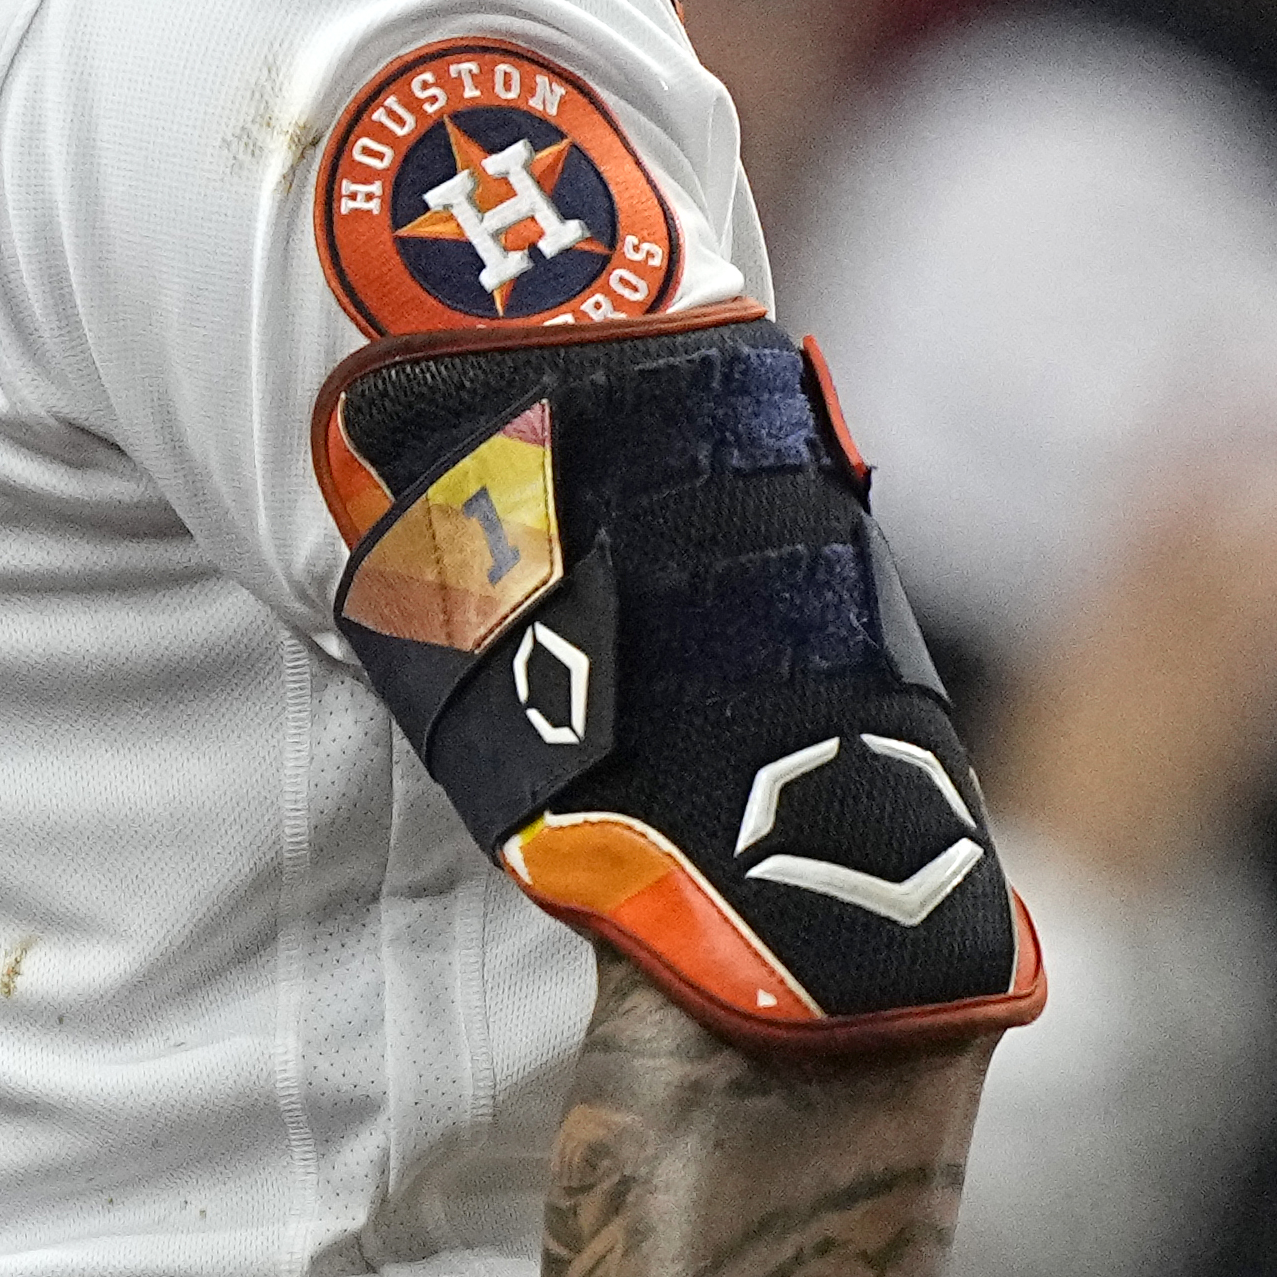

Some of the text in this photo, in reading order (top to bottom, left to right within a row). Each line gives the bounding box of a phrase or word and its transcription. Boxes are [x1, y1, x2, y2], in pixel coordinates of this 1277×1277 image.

[340, 61, 566, 215] HOUSTON
[423, 138, 592, 294] H
[462, 487, 521, 585] 1
